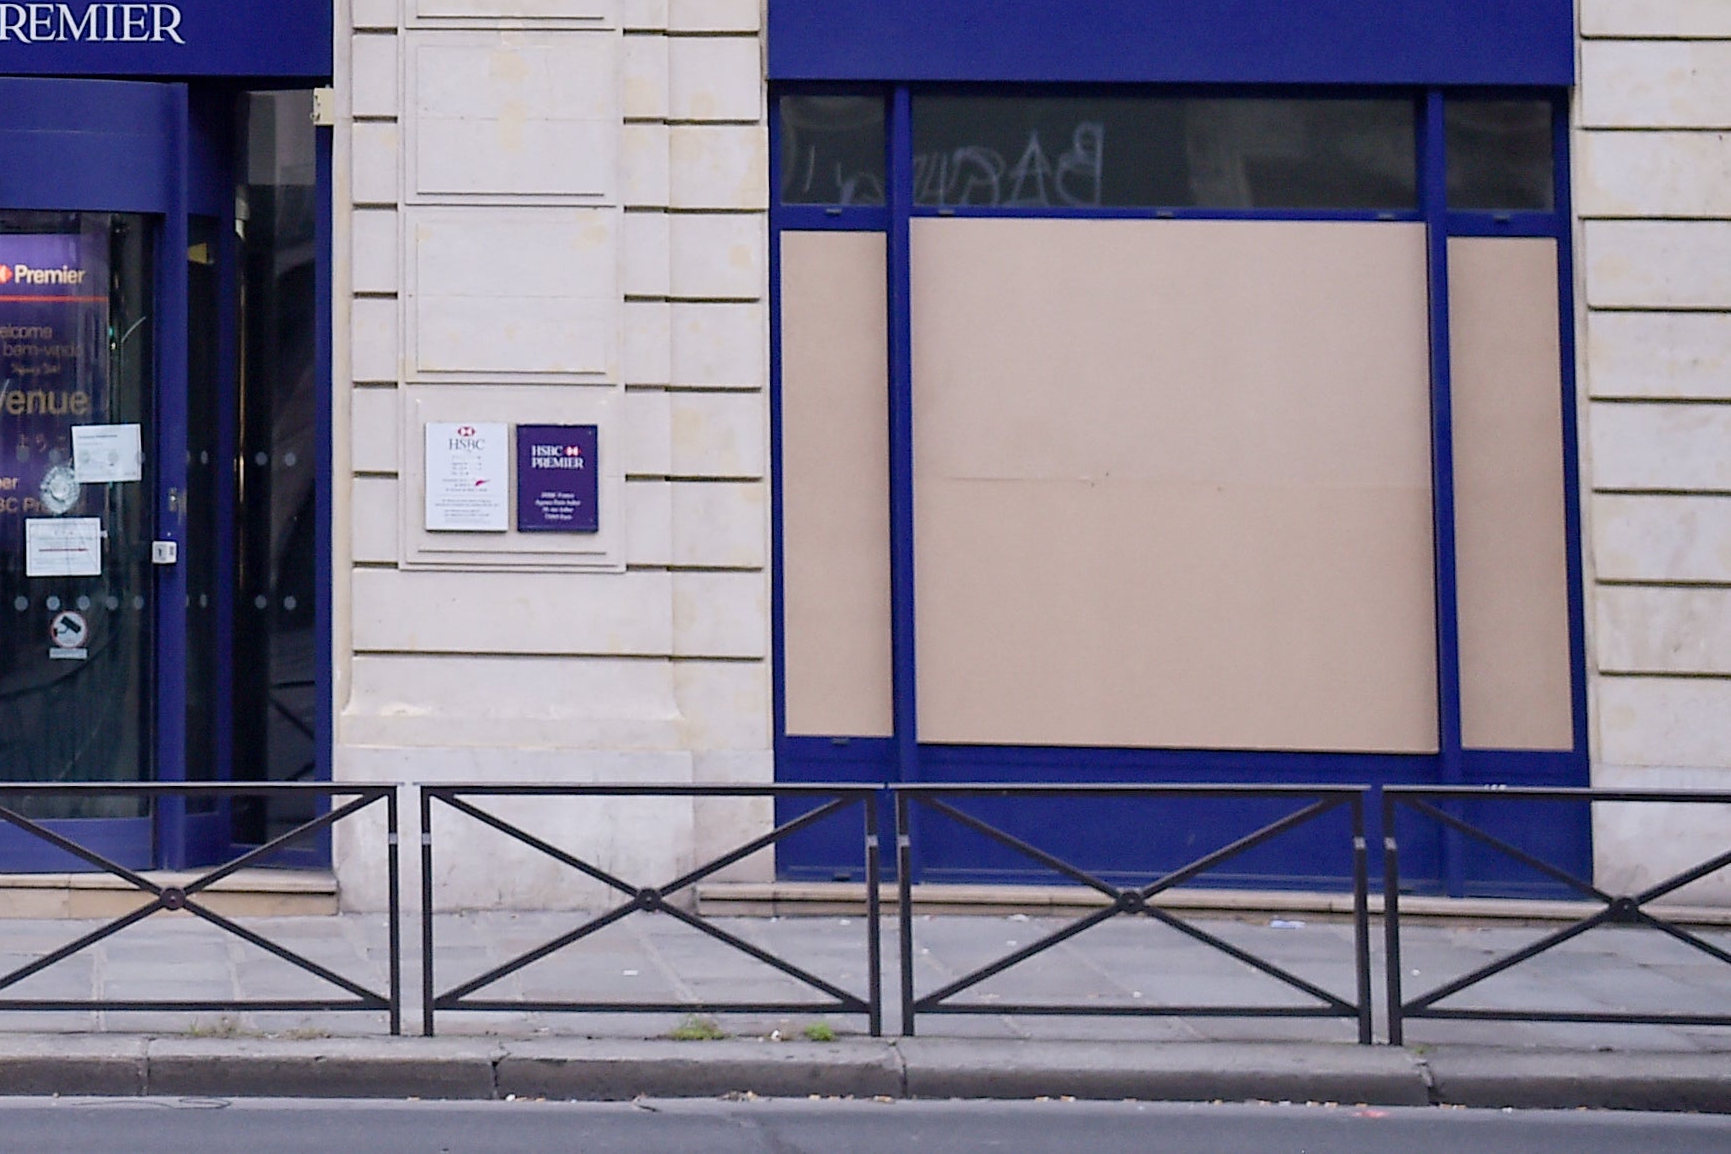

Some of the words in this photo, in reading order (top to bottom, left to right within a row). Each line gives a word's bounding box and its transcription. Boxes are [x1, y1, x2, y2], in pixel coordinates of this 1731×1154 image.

[14, 264, 86, 284] Premier
[448, 437, 486, 451] HSBC
[531, 445, 564, 457] HSBC
[531, 457, 585, 471] PREMIER
